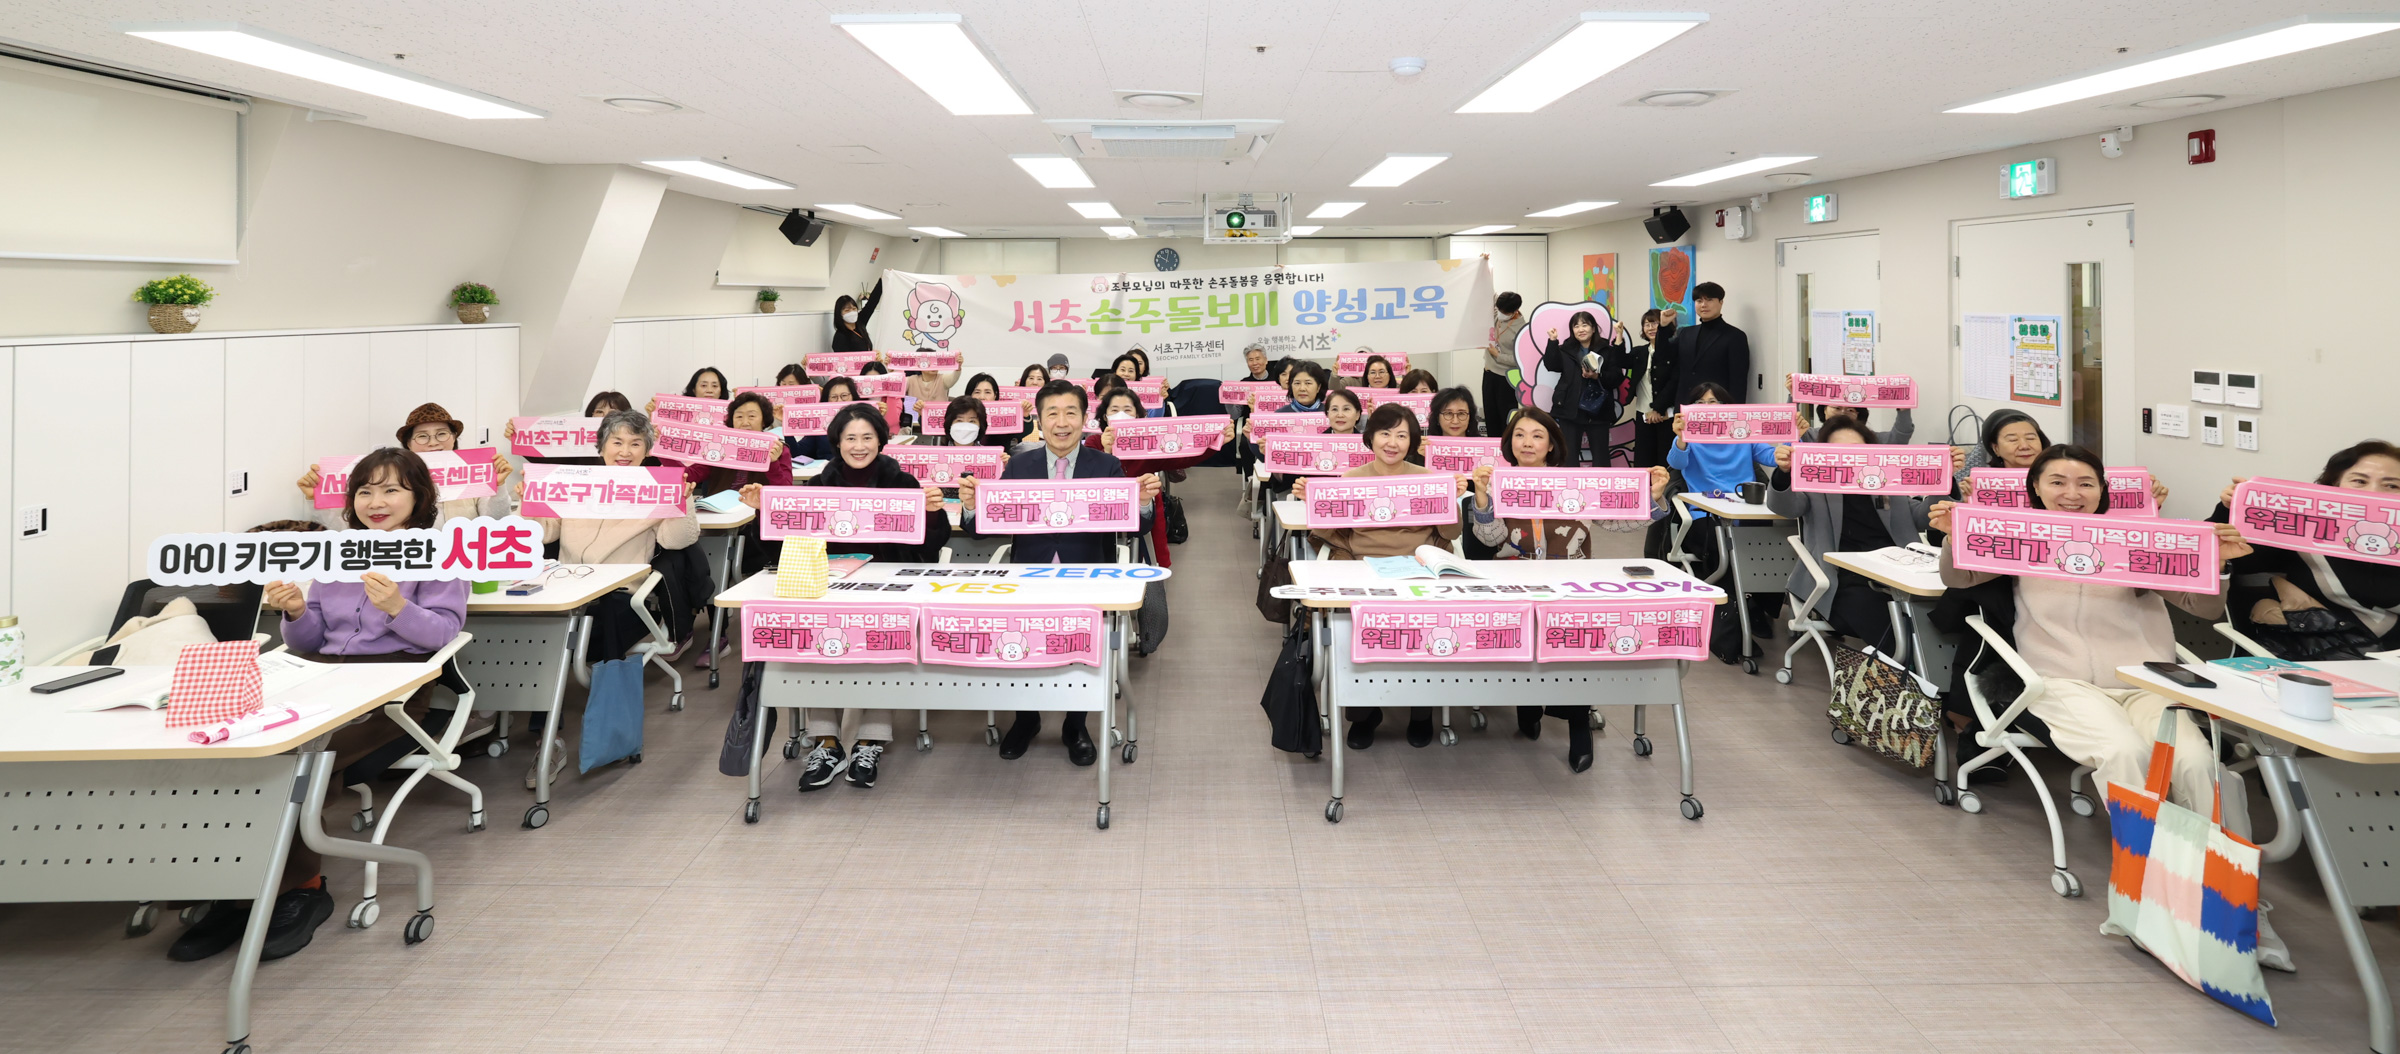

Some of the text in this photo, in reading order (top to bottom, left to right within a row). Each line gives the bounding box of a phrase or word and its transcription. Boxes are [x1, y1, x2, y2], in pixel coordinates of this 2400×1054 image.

[1110, 272, 1324, 293] 조부모님의 따뜻한 손주돌봄을 응원합니다!
[1008, 285, 1449, 335] 서초손주돌보미 양성교육
[1153, 339, 1225, 354] 서초구가족센터
[1271, 335, 1297, 344] 행복하고
[1298, 332, 1332, 352] 서초
[1156, 352, 1222, 362] SEOCHO FAMILY CENTER
[1860, 377, 1887, 386] 가족의
[1889, 377, 1910, 386] 행복
[1798, 381, 1910, 401] 우리가 함께!
[658, 401, 703, 412] 서초구 모든
[788, 409, 828, 418] 서초구 모든
[1000, 406, 1017, 415] 행복
[657, 409, 693, 423] 우리가
[787, 417, 822, 429] 우리가
[990, 416, 1017, 428] 함께!
[1300, 417, 1324, 426] 가족의
[1687, 411, 1793, 422] 서초구 모든 가족의 행복
[1116, 426, 1146, 437] 서초구
[1147, 425, 1169, 435] 모든
[1173, 423, 1203, 434] 가족의
[1686, 421, 1792, 435] 우리가 함께!
[660, 425, 771, 449] 서초구 모든 가족의 행복
[1116, 435, 1158, 451] 우리가
[659, 435, 770, 463] 우리가 함께!
[1271, 441, 1358, 453] 서초구 모든 가족의
[1432, 445, 1462, 457] 서초구
[1463, 446, 1485, 457] 모든
[918, 453, 997, 464] 모든 가족의 행복
[1271, 450, 1313, 467] 우리가
[1431, 456, 1475, 471] 우리가
[1800, 453, 1943, 468] 서초구 모든 가족의 행복
[1500, 476, 1640, 490] 서초구 모든 가족의 행복
[1800, 466, 1942, 486] 우리가 함께!
[1975, 476, 2143, 491] 서초구 행복
[524, 479, 682, 505] 서초구가족센터
[985, 488, 1130, 504] 서초구 모든 가족의 행복
[1313, 483, 1448, 500] 서초구 모든 가족의 행복
[1500, 489, 1640, 509] 우리가 함께!
[769, 496, 916, 514] 서초구 모든 가족의 행복
[985, 502, 1130, 522] 우리가 함께!
[1314, 497, 1449, 518] 우리가 함께!
[2245, 489, 2314, 514] 서초구
[2317, 499, 2367, 521] 모든
[770, 511, 916, 533] 우리가 함께!
[2245, 506, 2340, 541] 우리가
[1966, 516, 2201, 552] 서초구 모든 가족의 행복
[159, 525, 533, 575] 아이 키우기 행복한 서초
[1966, 533, 2201, 578] 우리가 함께!
[1019, 567, 1163, 579] ZERO
[927, 581, 1020, 595] YES
[1561, 580, 1714, 593] 100%
[752, 611, 911, 629] 서초구 모든 가족의 행복
[931, 615, 1092, 633] 서초구 모든 가족의 행복
[1361, 611, 1522, 628] 서초구 모든 가족의 행복
[1545, 609, 1704, 628] 서초구 모든 가족의 행복
[752, 628, 912, 651] 우리가 함께!
[931, 631, 1092, 654] 우리가 함께!
[1361, 627, 1522, 650] 우리가 함께!
[1544, 626, 1703, 650] 우리가 함께!
